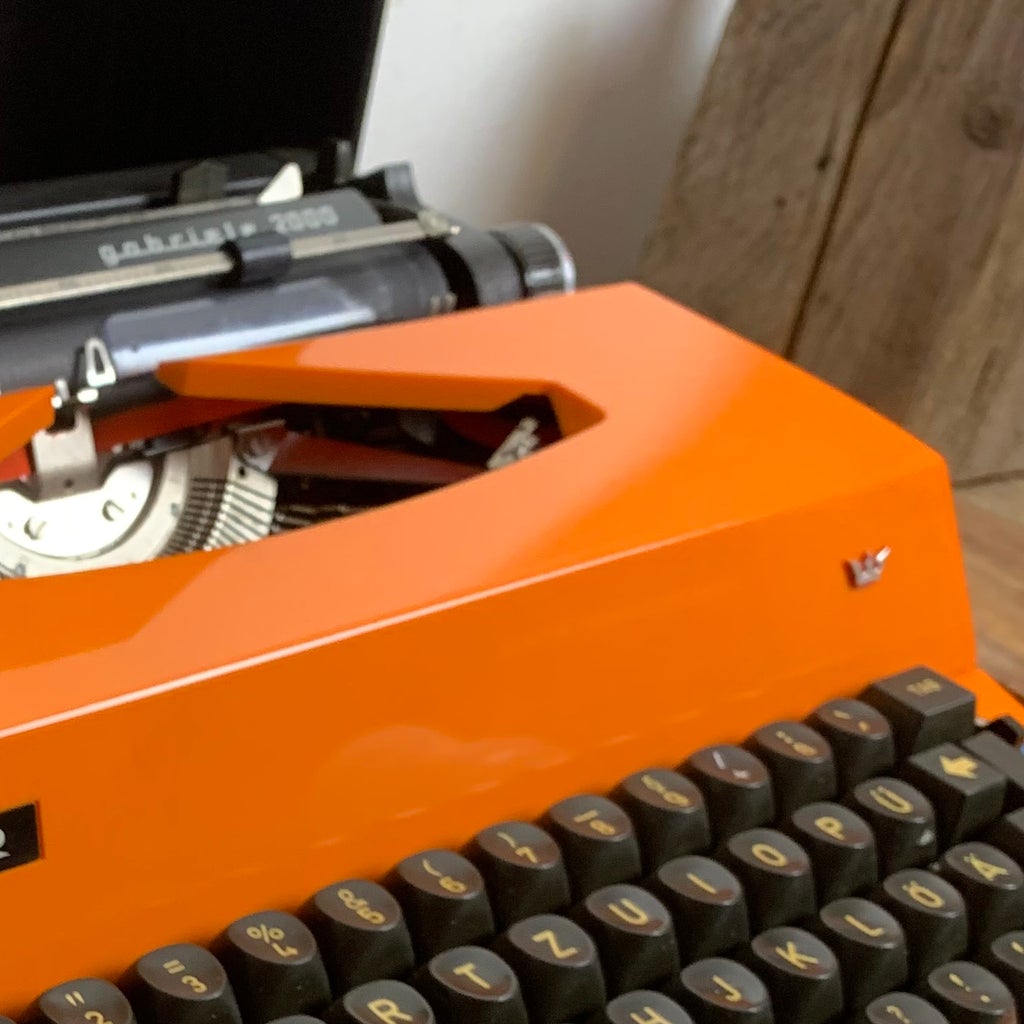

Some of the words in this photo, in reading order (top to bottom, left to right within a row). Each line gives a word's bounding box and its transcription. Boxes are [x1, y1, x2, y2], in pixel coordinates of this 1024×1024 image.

[814, 816, 845, 840] P
[515, 846, 538, 864] 7
[751, 843, 788, 867] O
[963, 852, 1009, 881] Ä
[438, 874, 468, 893] 6
[686, 873, 717, 894] I
[901, 880, 945, 909] Ö
[354, 905, 386, 925] 5
[608, 897, 651, 925] U
[246, 923, 285, 944] %
[844, 914, 885, 937] L
[273, 942, 298, 957] 4
[531, 929, 578, 959] Z
[775, 941, 820, 969] K
[181, 975, 208, 993] 3
[453, 962, 491, 989] T
[712, 973, 744, 1003] J
